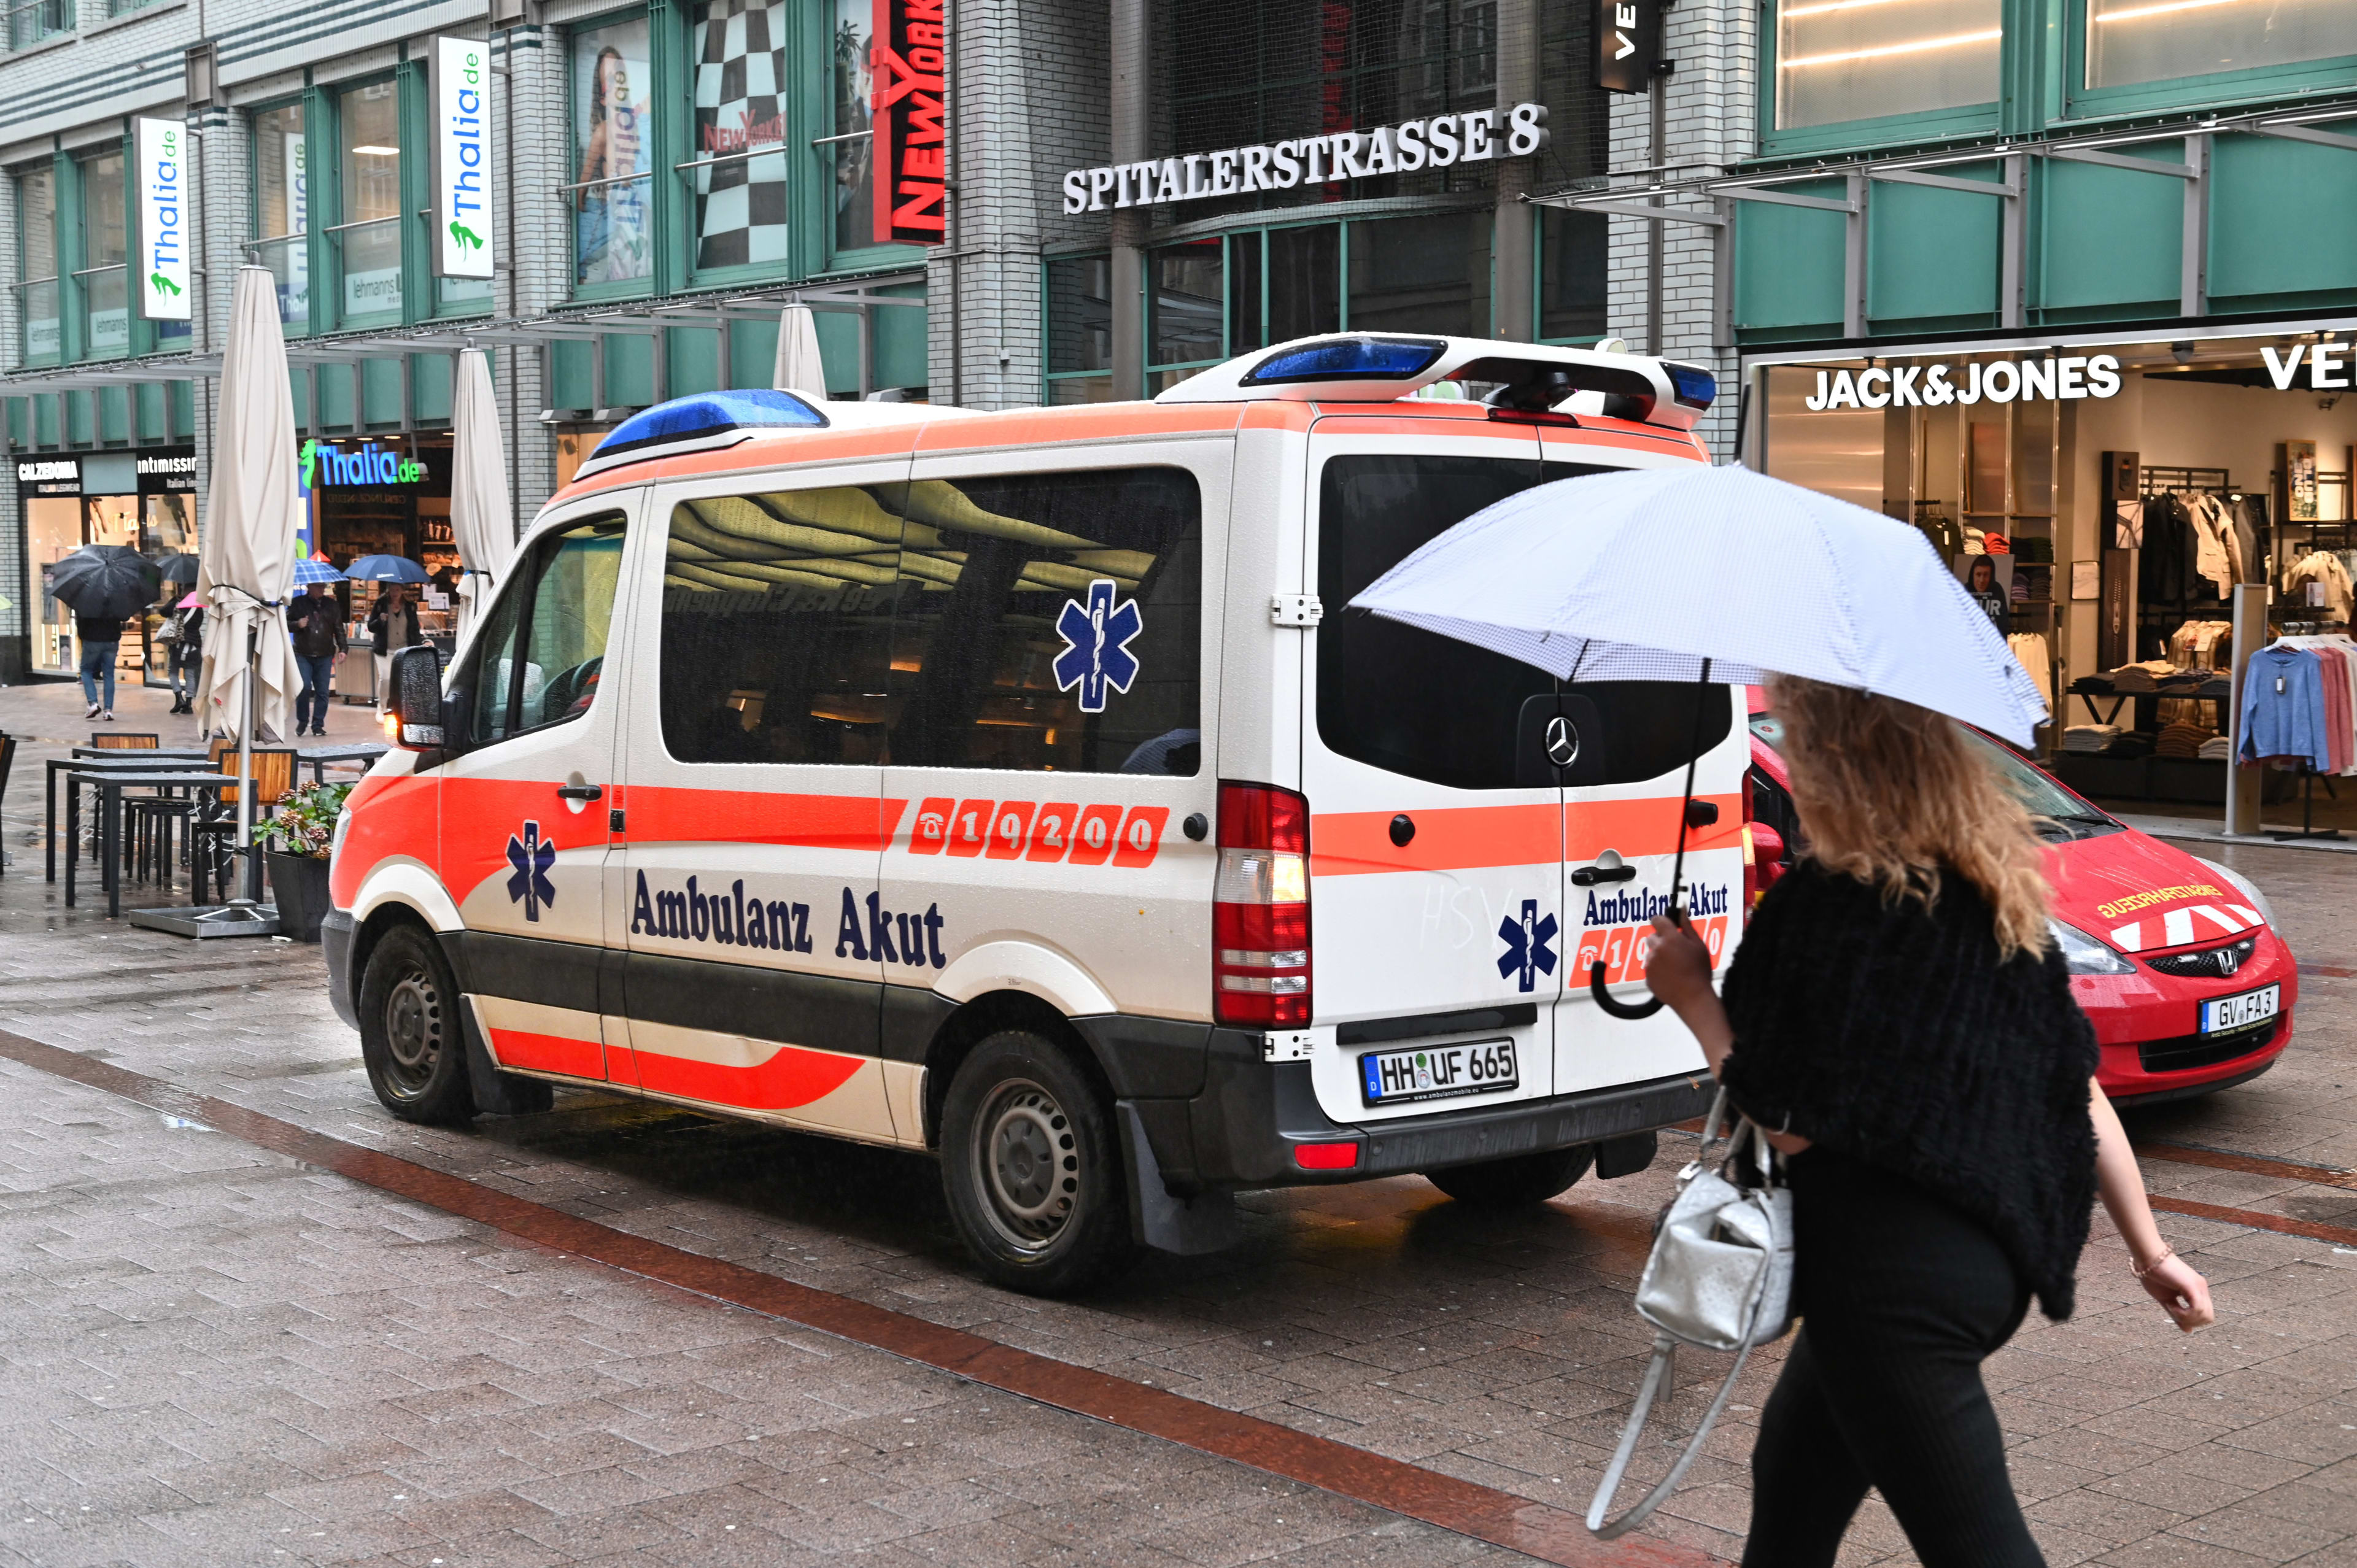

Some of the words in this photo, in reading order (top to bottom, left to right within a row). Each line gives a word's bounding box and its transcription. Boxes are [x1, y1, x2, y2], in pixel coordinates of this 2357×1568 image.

[1615, 2, 1636, 60] VE
[453, 53, 481, 217] Thalia.de
[1062, 109, 1493, 215] SPITALERSTRASSE
[1509, 103, 1541, 156] 8
[153, 131, 179, 269] Thalia.de
[354, 279, 394, 299] lehmanns
[1805, 354, 2119, 411] JACK&JONES
[2259, 342, 2357, 390] VE
[316, 443, 419, 485] Thalia.de
[961, 811, 1153, 851] 19200
[631, 868, 813, 954] Ambulanz
[835, 886, 946, 969] Akut
[1584, 887, 1673, 926] Ambulan
[1687, 882, 1727, 917] Akut
[2220, 1000, 2238, 1025] GV
[2247, 994, 2261, 1020] FA
[2264, 991, 2271, 1014] 3
[1370, 1081, 1377, 1091] D
[1381, 1056, 1416, 1092] HH
[1431, 1051, 1461, 1085] UF
[1469, 1045, 1512, 1081] 665
[1414, 1088, 1479, 1100] www.ambulanzmobile.eu
